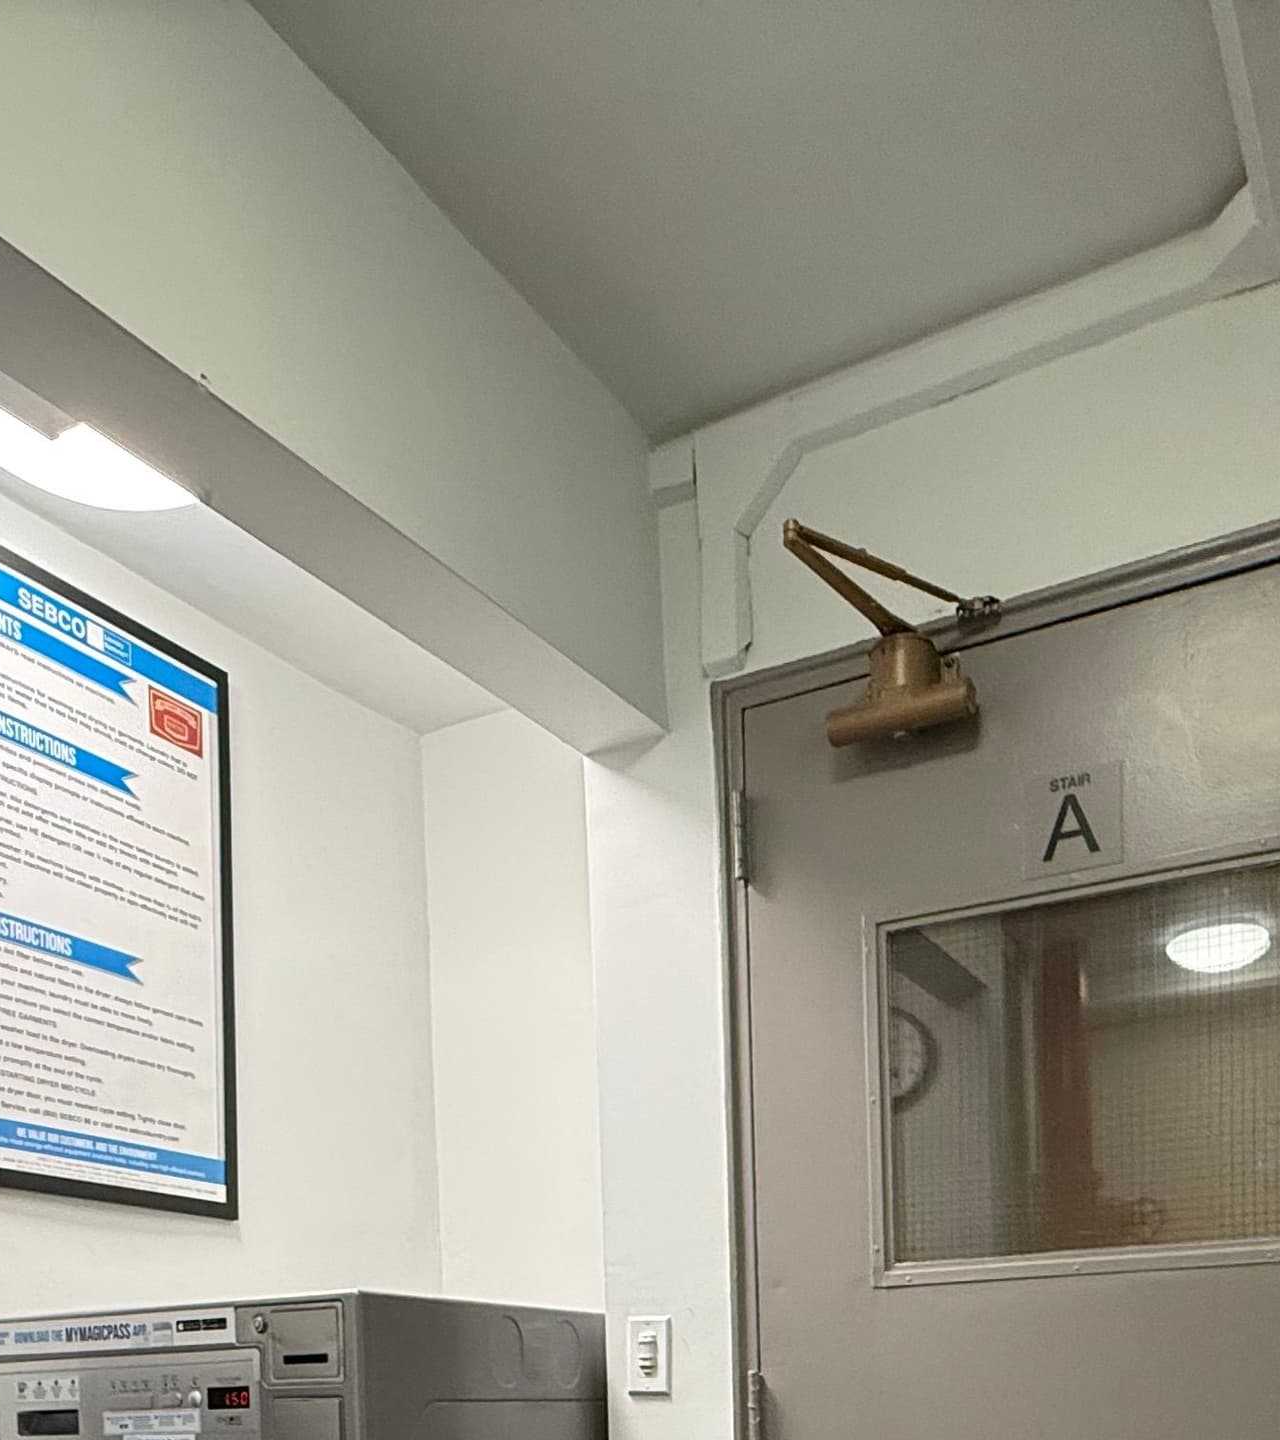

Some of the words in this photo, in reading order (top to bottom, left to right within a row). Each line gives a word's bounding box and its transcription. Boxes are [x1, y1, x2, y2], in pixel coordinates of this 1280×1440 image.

[16, 584, 86, 642] SEBCO
[1049, 773, 1091, 792] STAIR
[1042, 794, 1101, 862] A
[65, 1323, 131, 1342] MYMAGICPASS
